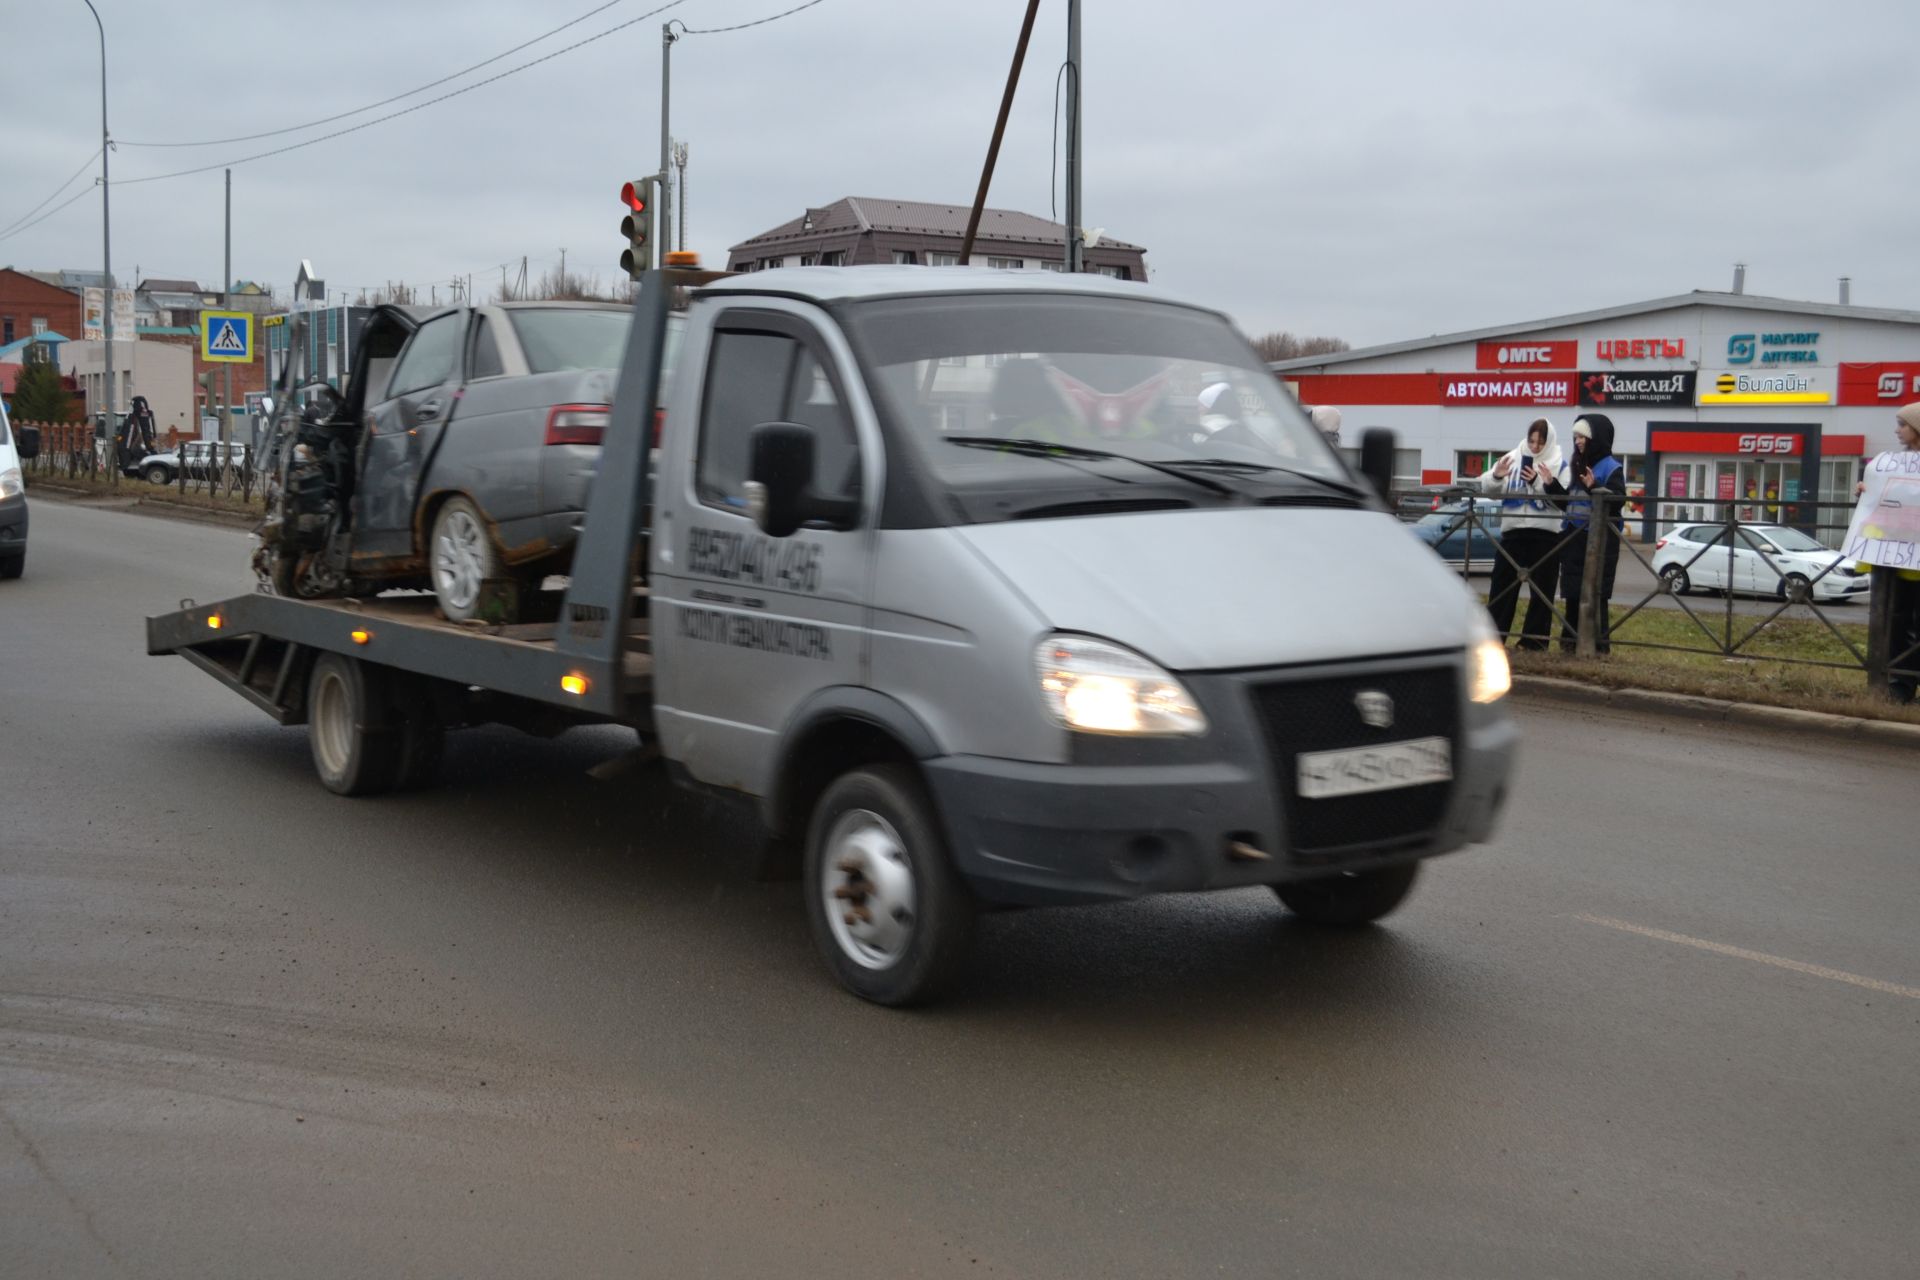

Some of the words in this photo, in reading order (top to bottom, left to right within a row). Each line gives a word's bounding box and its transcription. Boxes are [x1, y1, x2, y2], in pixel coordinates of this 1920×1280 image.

[1761, 332, 1819, 345] МАГНИТ
[1510, 347, 1552, 363] МТС
[1597, 338, 1686, 361] ЦВЕТЫ
[1760, 350, 1819, 362] АПТЕКА
[1446, 381, 1567, 398] АВТОМАГАЗИН
[1601, 374, 1685, 393] КамелиЯ
[1738, 373, 1809, 391] Билайн
[1876, 449, 1920, 474] СБАВ
[1848, 536, 1868, 560] И
[1875, 539, 1915, 568] ТЕБЯ
